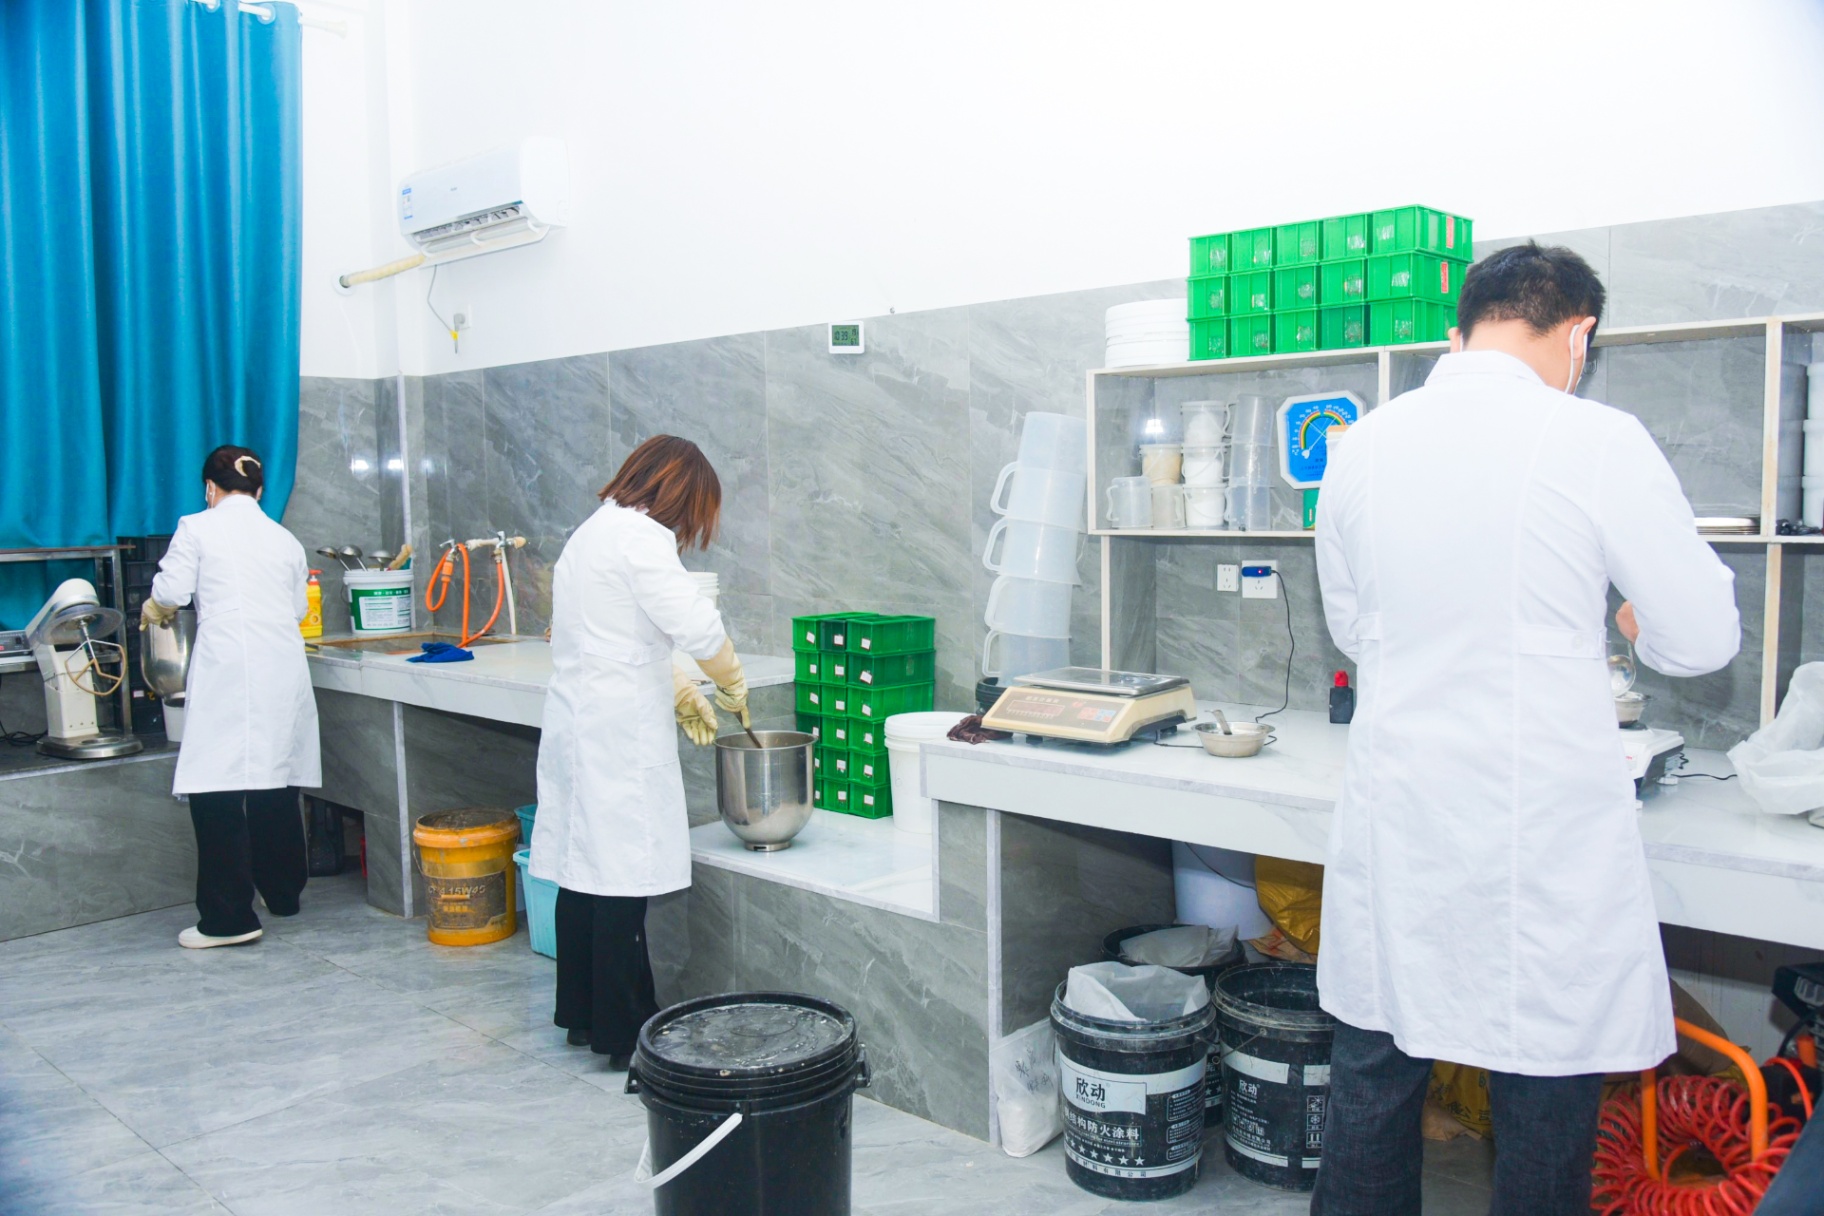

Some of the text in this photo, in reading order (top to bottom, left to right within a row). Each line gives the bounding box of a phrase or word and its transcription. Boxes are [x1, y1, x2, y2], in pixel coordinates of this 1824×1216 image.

[1076, 1077, 1106, 1102] 欣动
[1239, 1079, 1258, 1097] 欣动
[1076, 1095, 1106, 1109] XINDONG
